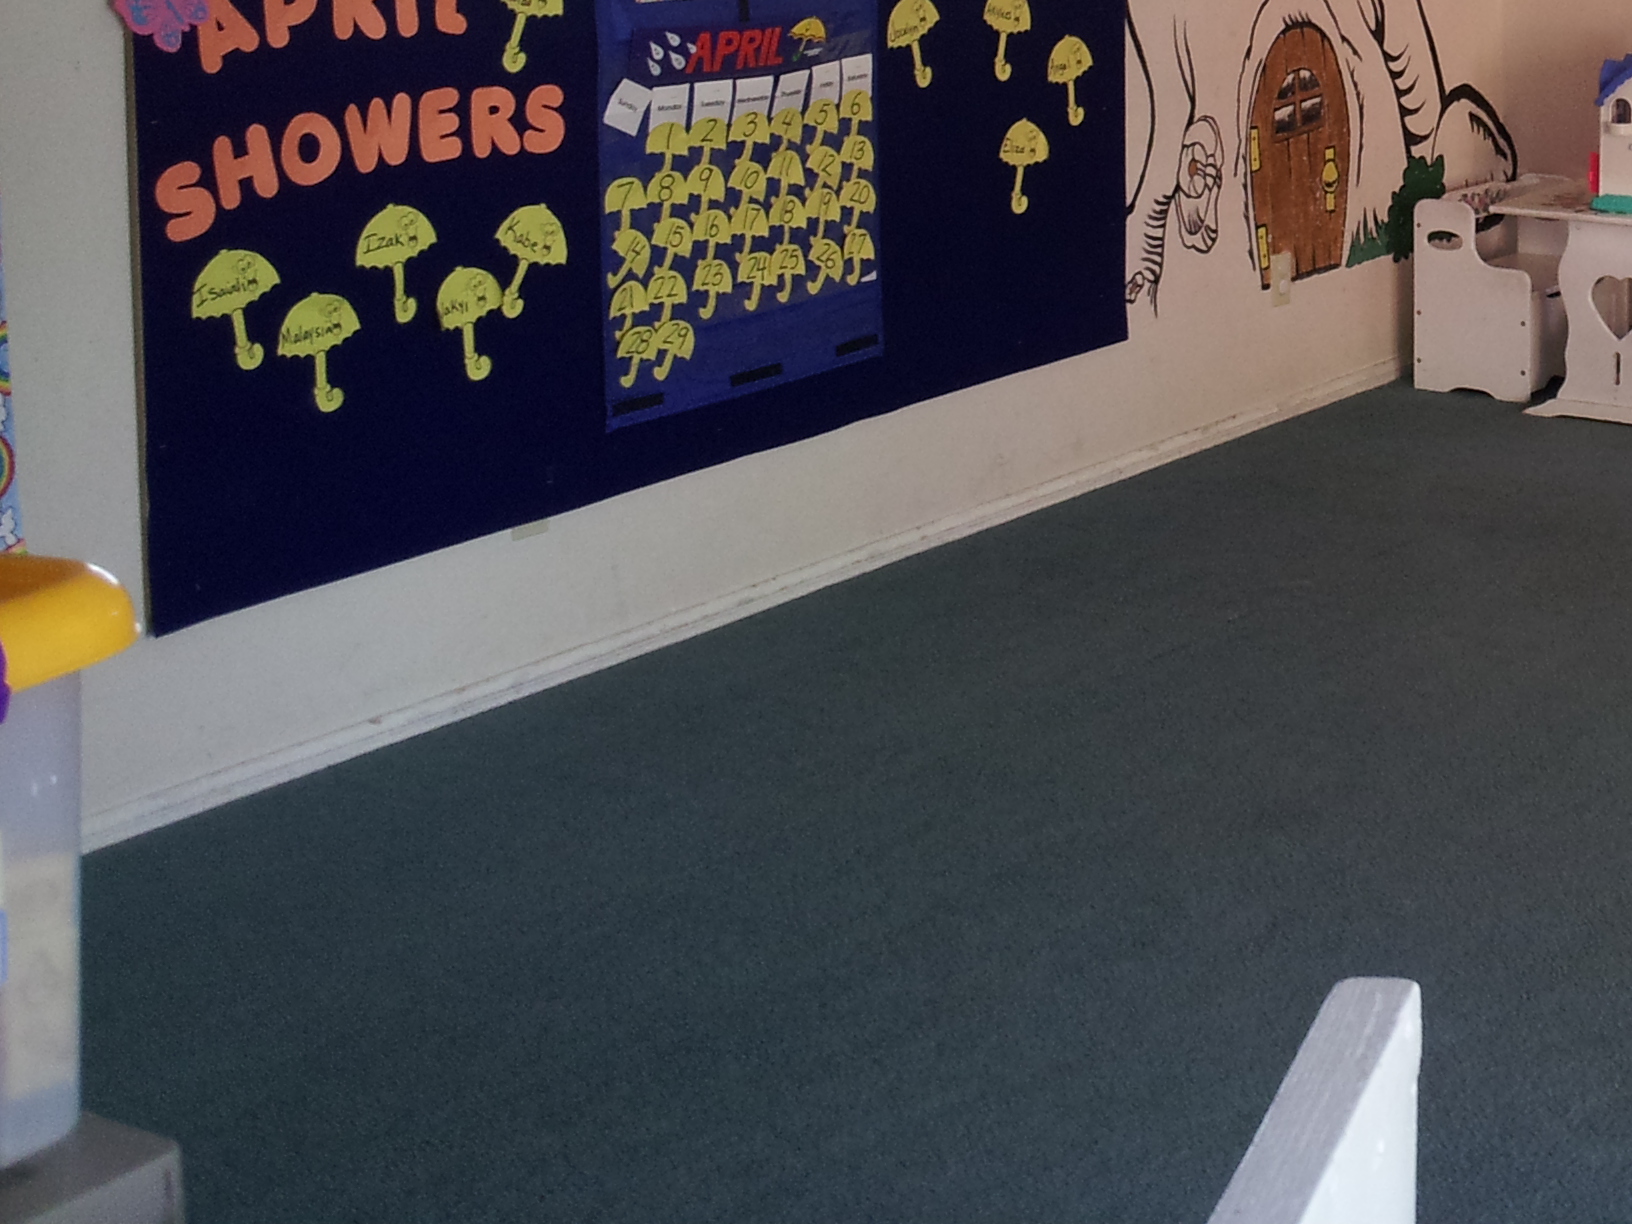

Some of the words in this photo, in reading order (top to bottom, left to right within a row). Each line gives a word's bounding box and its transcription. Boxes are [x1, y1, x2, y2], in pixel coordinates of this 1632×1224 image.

[686, 26, 784, 74] APRIL
[814, 103, 831, 125] 5
[850, 92, 862, 116] 6
[701, 119, 717, 143] 2
[743, 112, 758, 137] 3
[782, 111, 795, 135] 4
[665, 122, 675, 150] 1
[849, 140, 866, 161] 13
[155, 85, 566, 243] SHOWERS
[779, 157, 793, 177] 11
[818, 152, 836, 176] 12
[658, 173, 675, 202] 8
[699, 167, 714, 193] 9
[740, 167, 760, 190] 10
[617, 181, 635, 209] 7
[818, 191, 832, 216] 19
[849, 181, 871, 205] 20
[744, 206, 761, 231] 17
[781, 197, 796, 224] 18
[665, 222, 684, 248] 15
[704, 214, 720, 238] 16
[363, 233, 404, 254] Izak
[625, 236, 646, 264] 14
[816, 242, 838, 270] 26
[746, 256, 767, 282] 24
[778, 248, 799, 271] 25
[653, 275, 679, 300] 22
[701, 263, 724, 287] 23
[617, 285, 634, 312] 21
[625, 329, 653, 355] 28
[662, 322, 689, 351] 29
